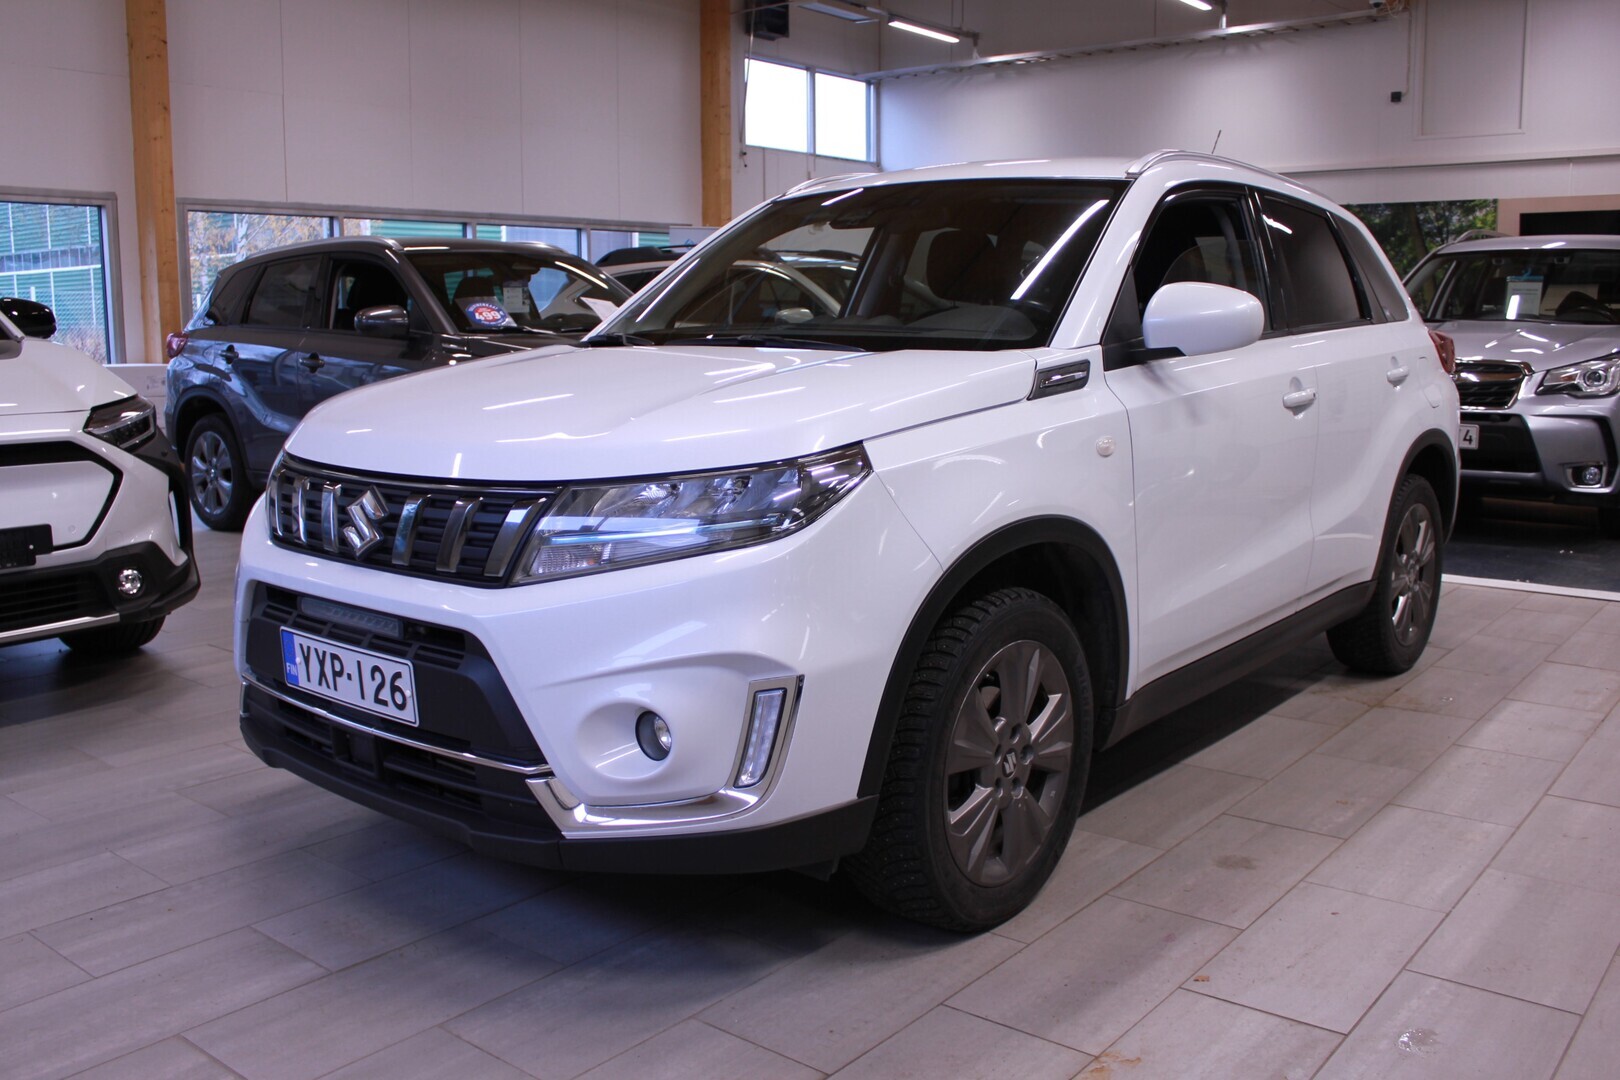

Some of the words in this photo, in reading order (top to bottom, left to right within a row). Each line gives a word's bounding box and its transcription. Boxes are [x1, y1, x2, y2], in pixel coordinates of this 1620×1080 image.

[1460, 429, 1473, 445] 4
[286, 662, 298, 676] FIN
[299, 643, 407, 711] YXP-126
